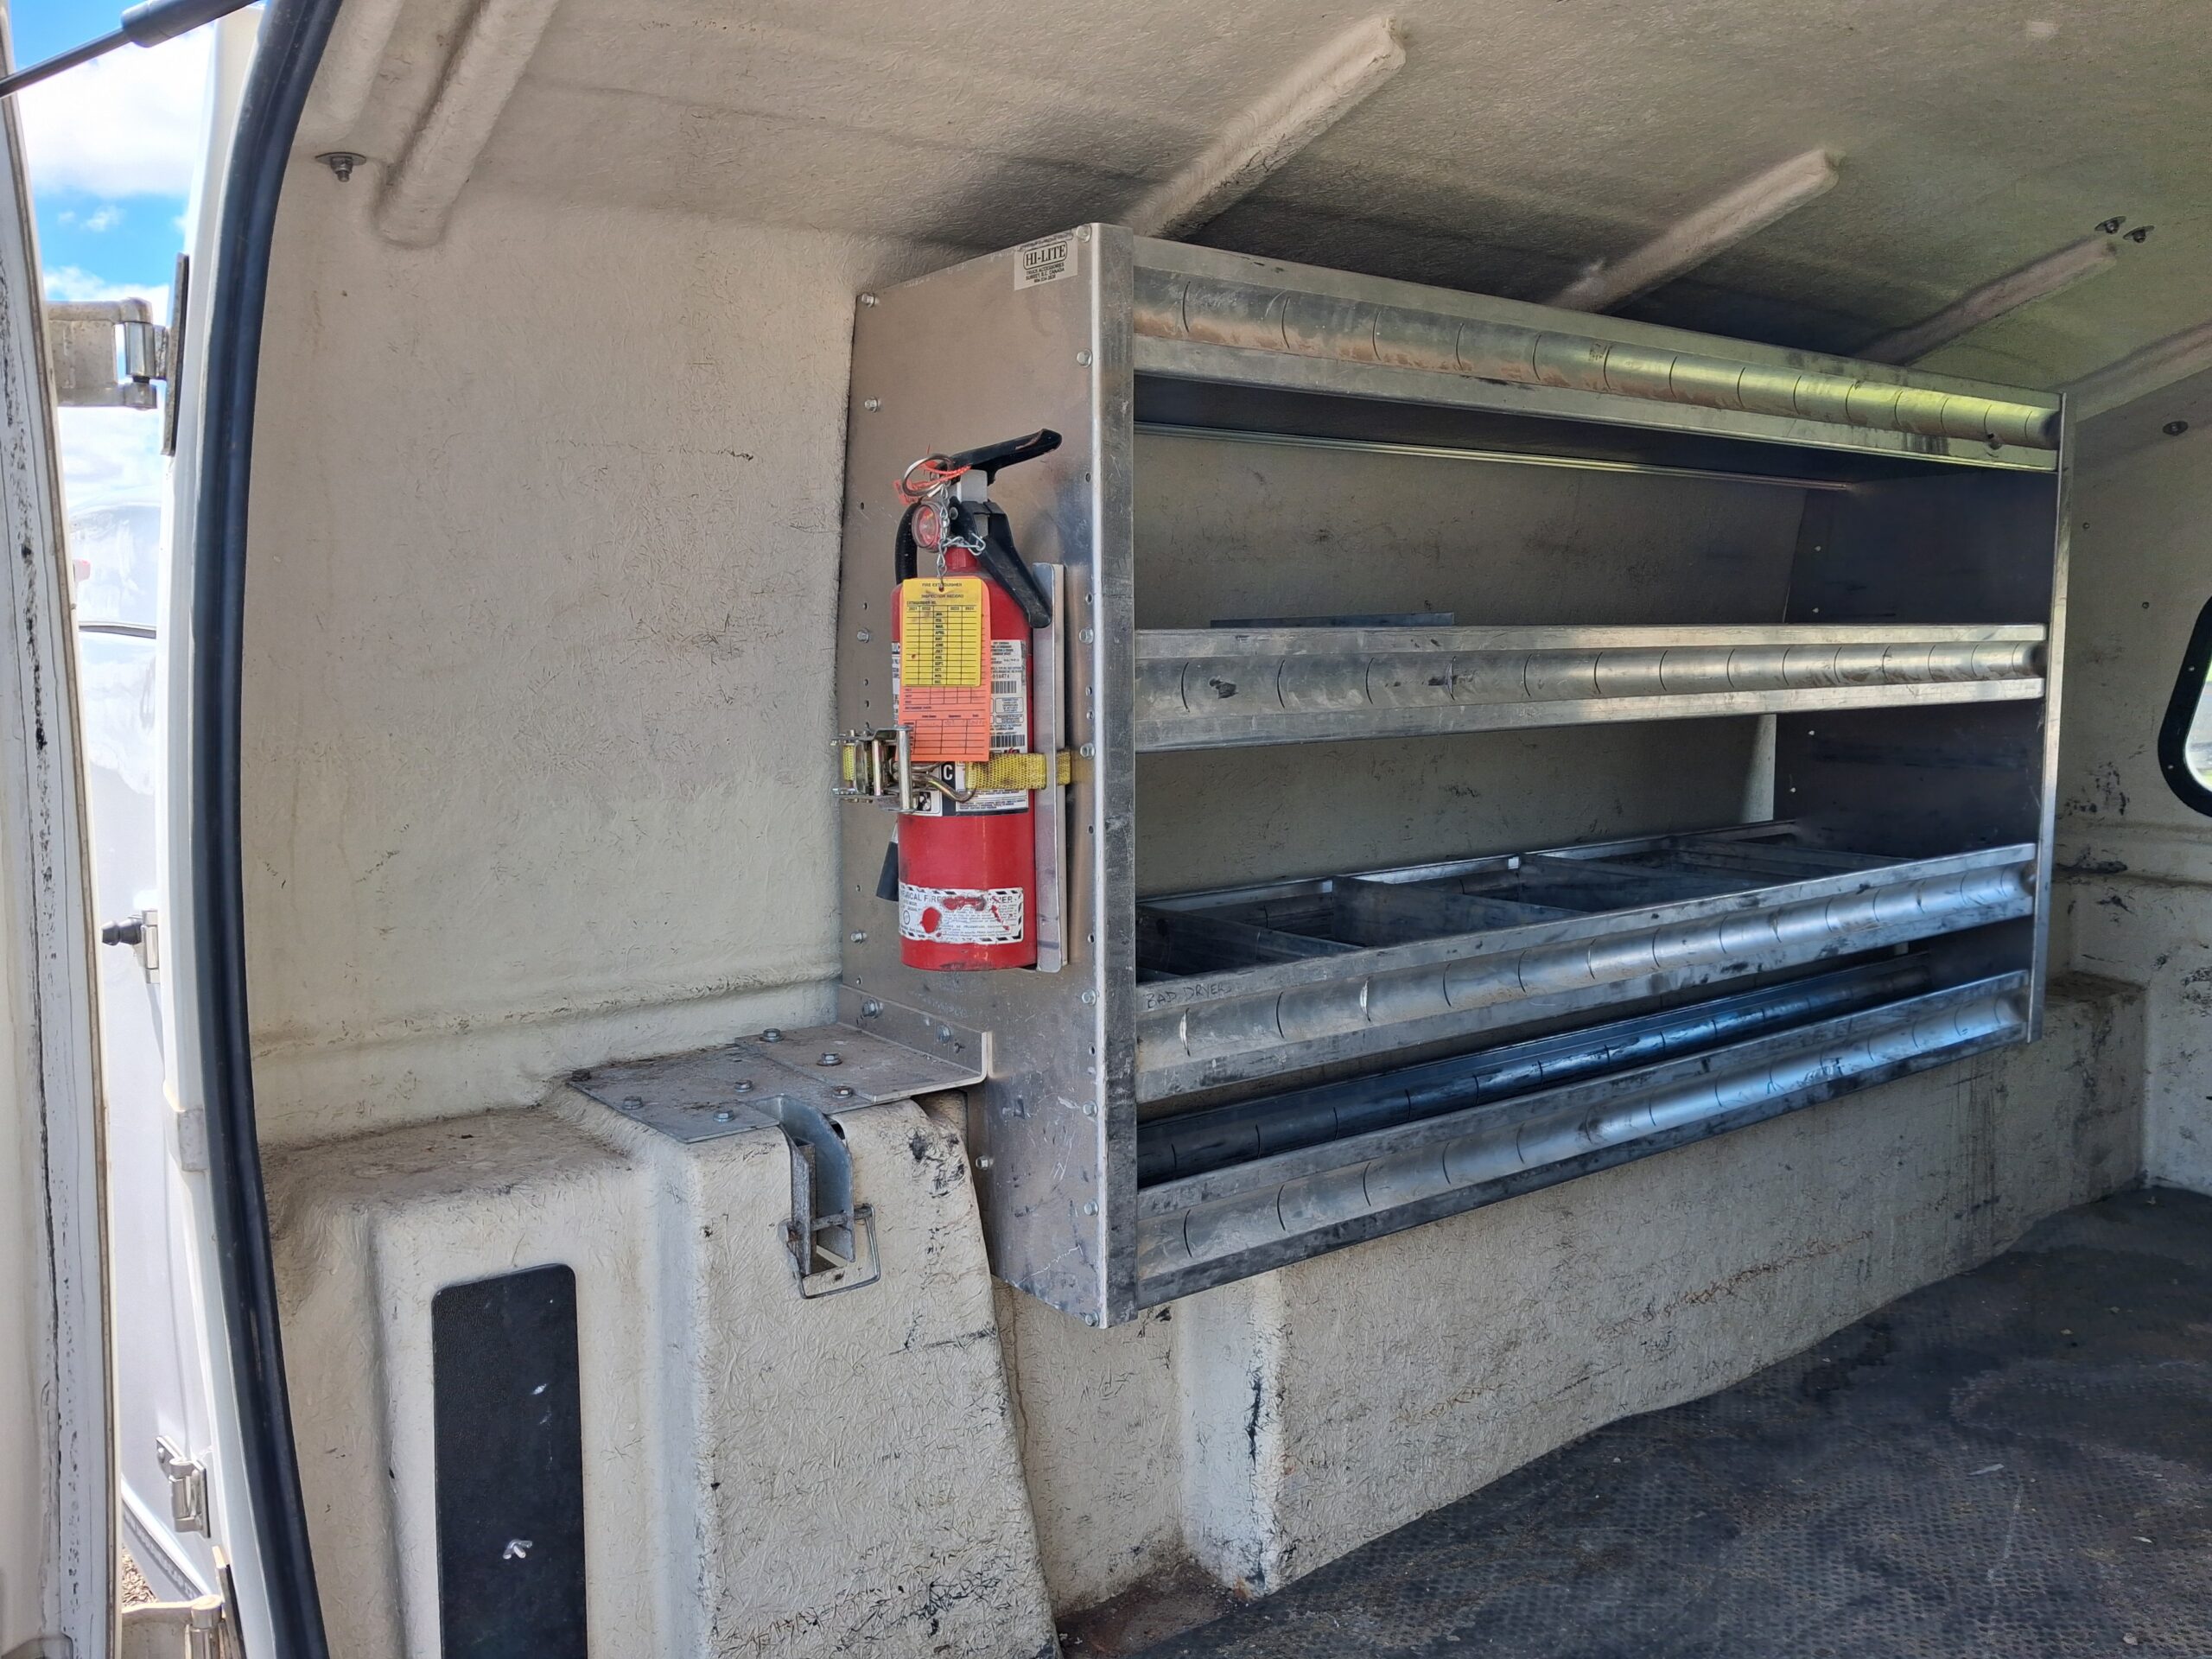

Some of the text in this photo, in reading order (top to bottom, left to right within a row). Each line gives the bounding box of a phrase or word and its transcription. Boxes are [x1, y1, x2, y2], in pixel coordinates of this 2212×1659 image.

[1026, 245, 1065, 266] HI-LITE
[1039, 262, 1065, 272] ACCESSORIES
[943, 764, 953, 780] C
[1146, 991, 1176, 1008] BAD
